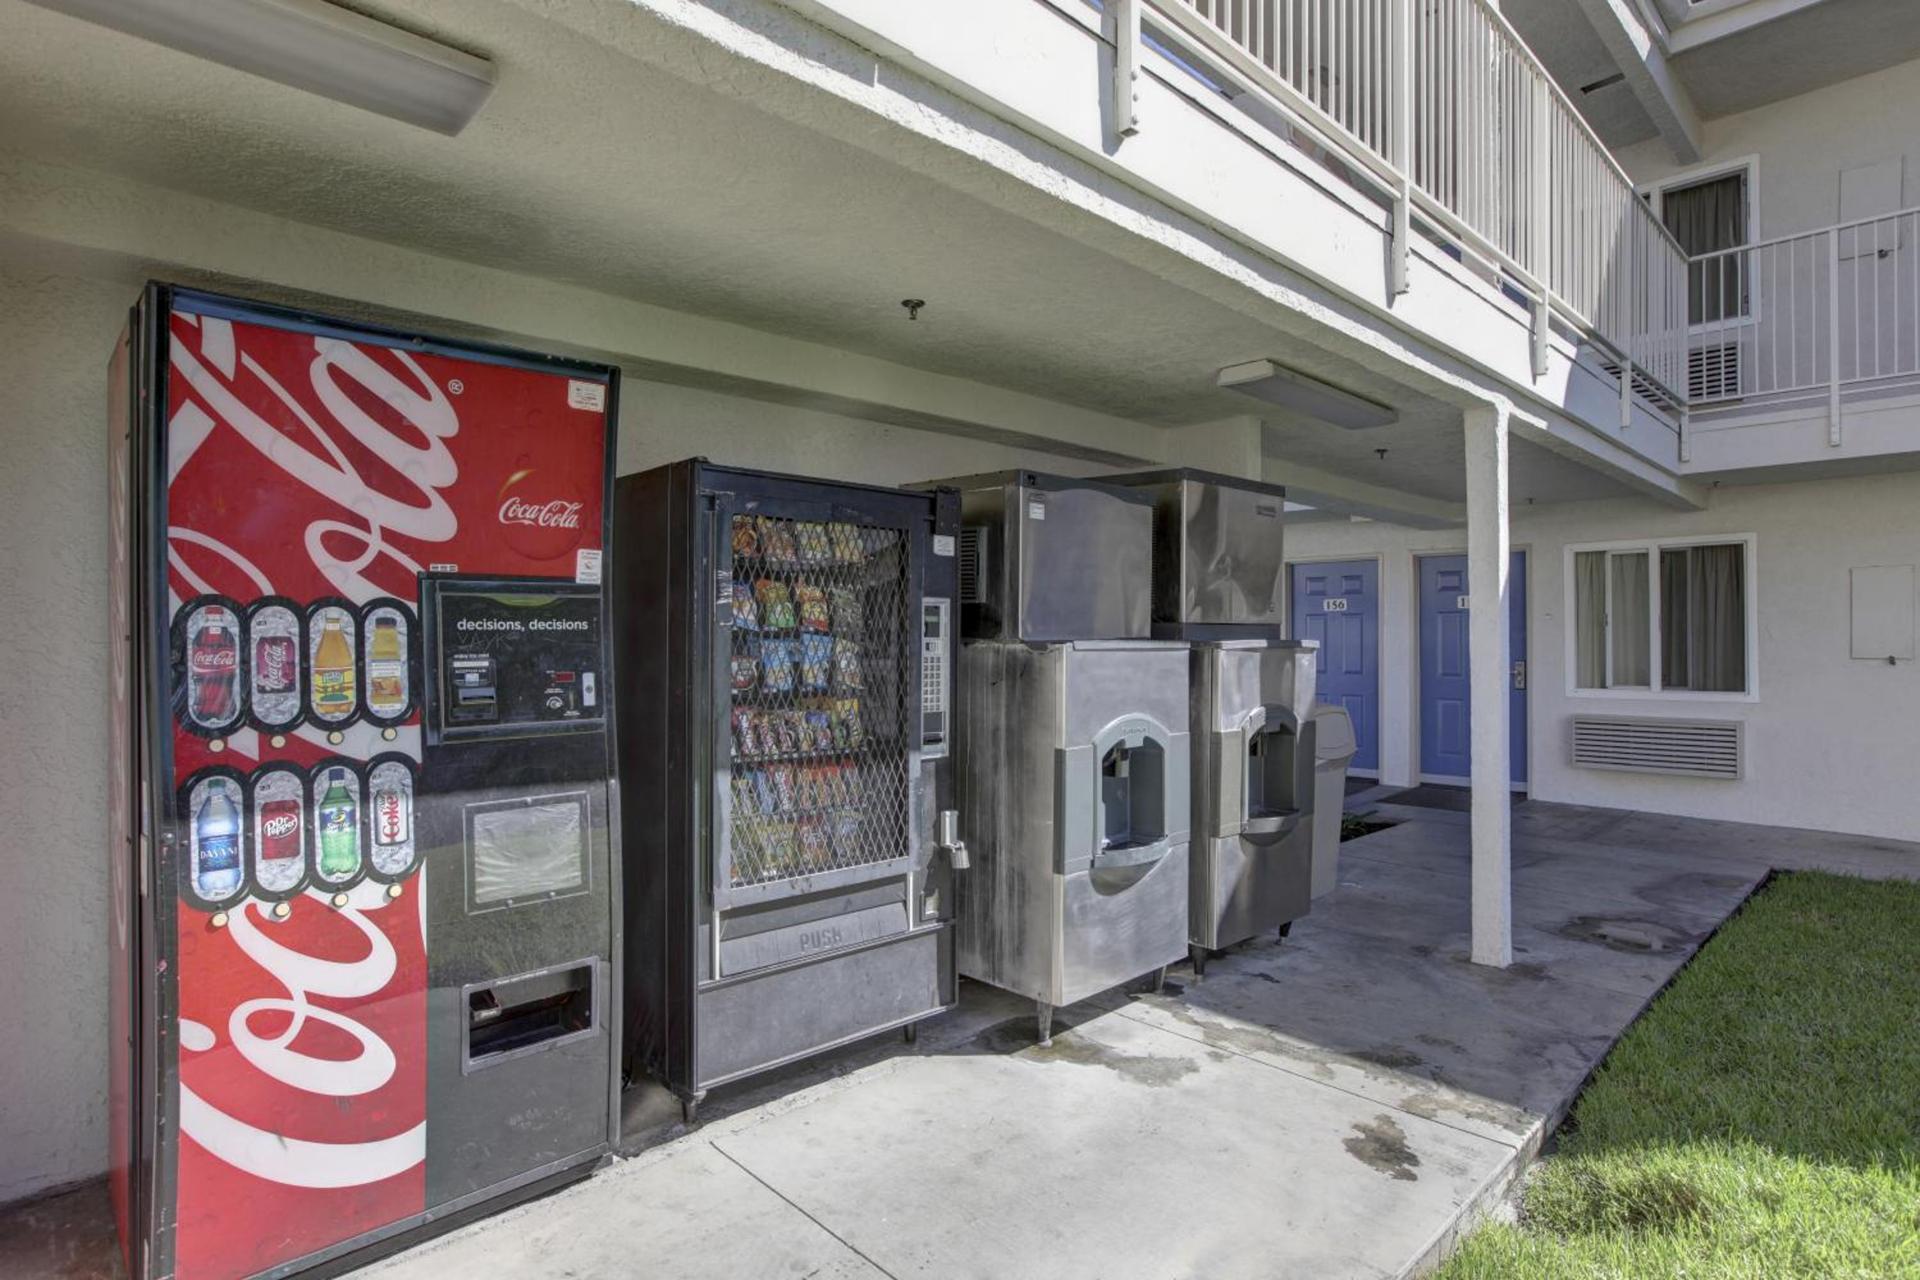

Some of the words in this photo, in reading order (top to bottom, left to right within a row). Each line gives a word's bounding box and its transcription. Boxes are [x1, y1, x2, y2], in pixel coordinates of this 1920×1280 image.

[498, 496, 584, 529] Coca-Cola
[1325, 599, 1345, 610] 156
[456, 617, 526, 632] decisions,
[528, 618, 589, 631] decisions
[275, 816, 289, 827] Dr
[382, 794, 400, 838] Coke
[200, 846, 239, 860] DASANI
[799, 926, 842, 951] PUSH
